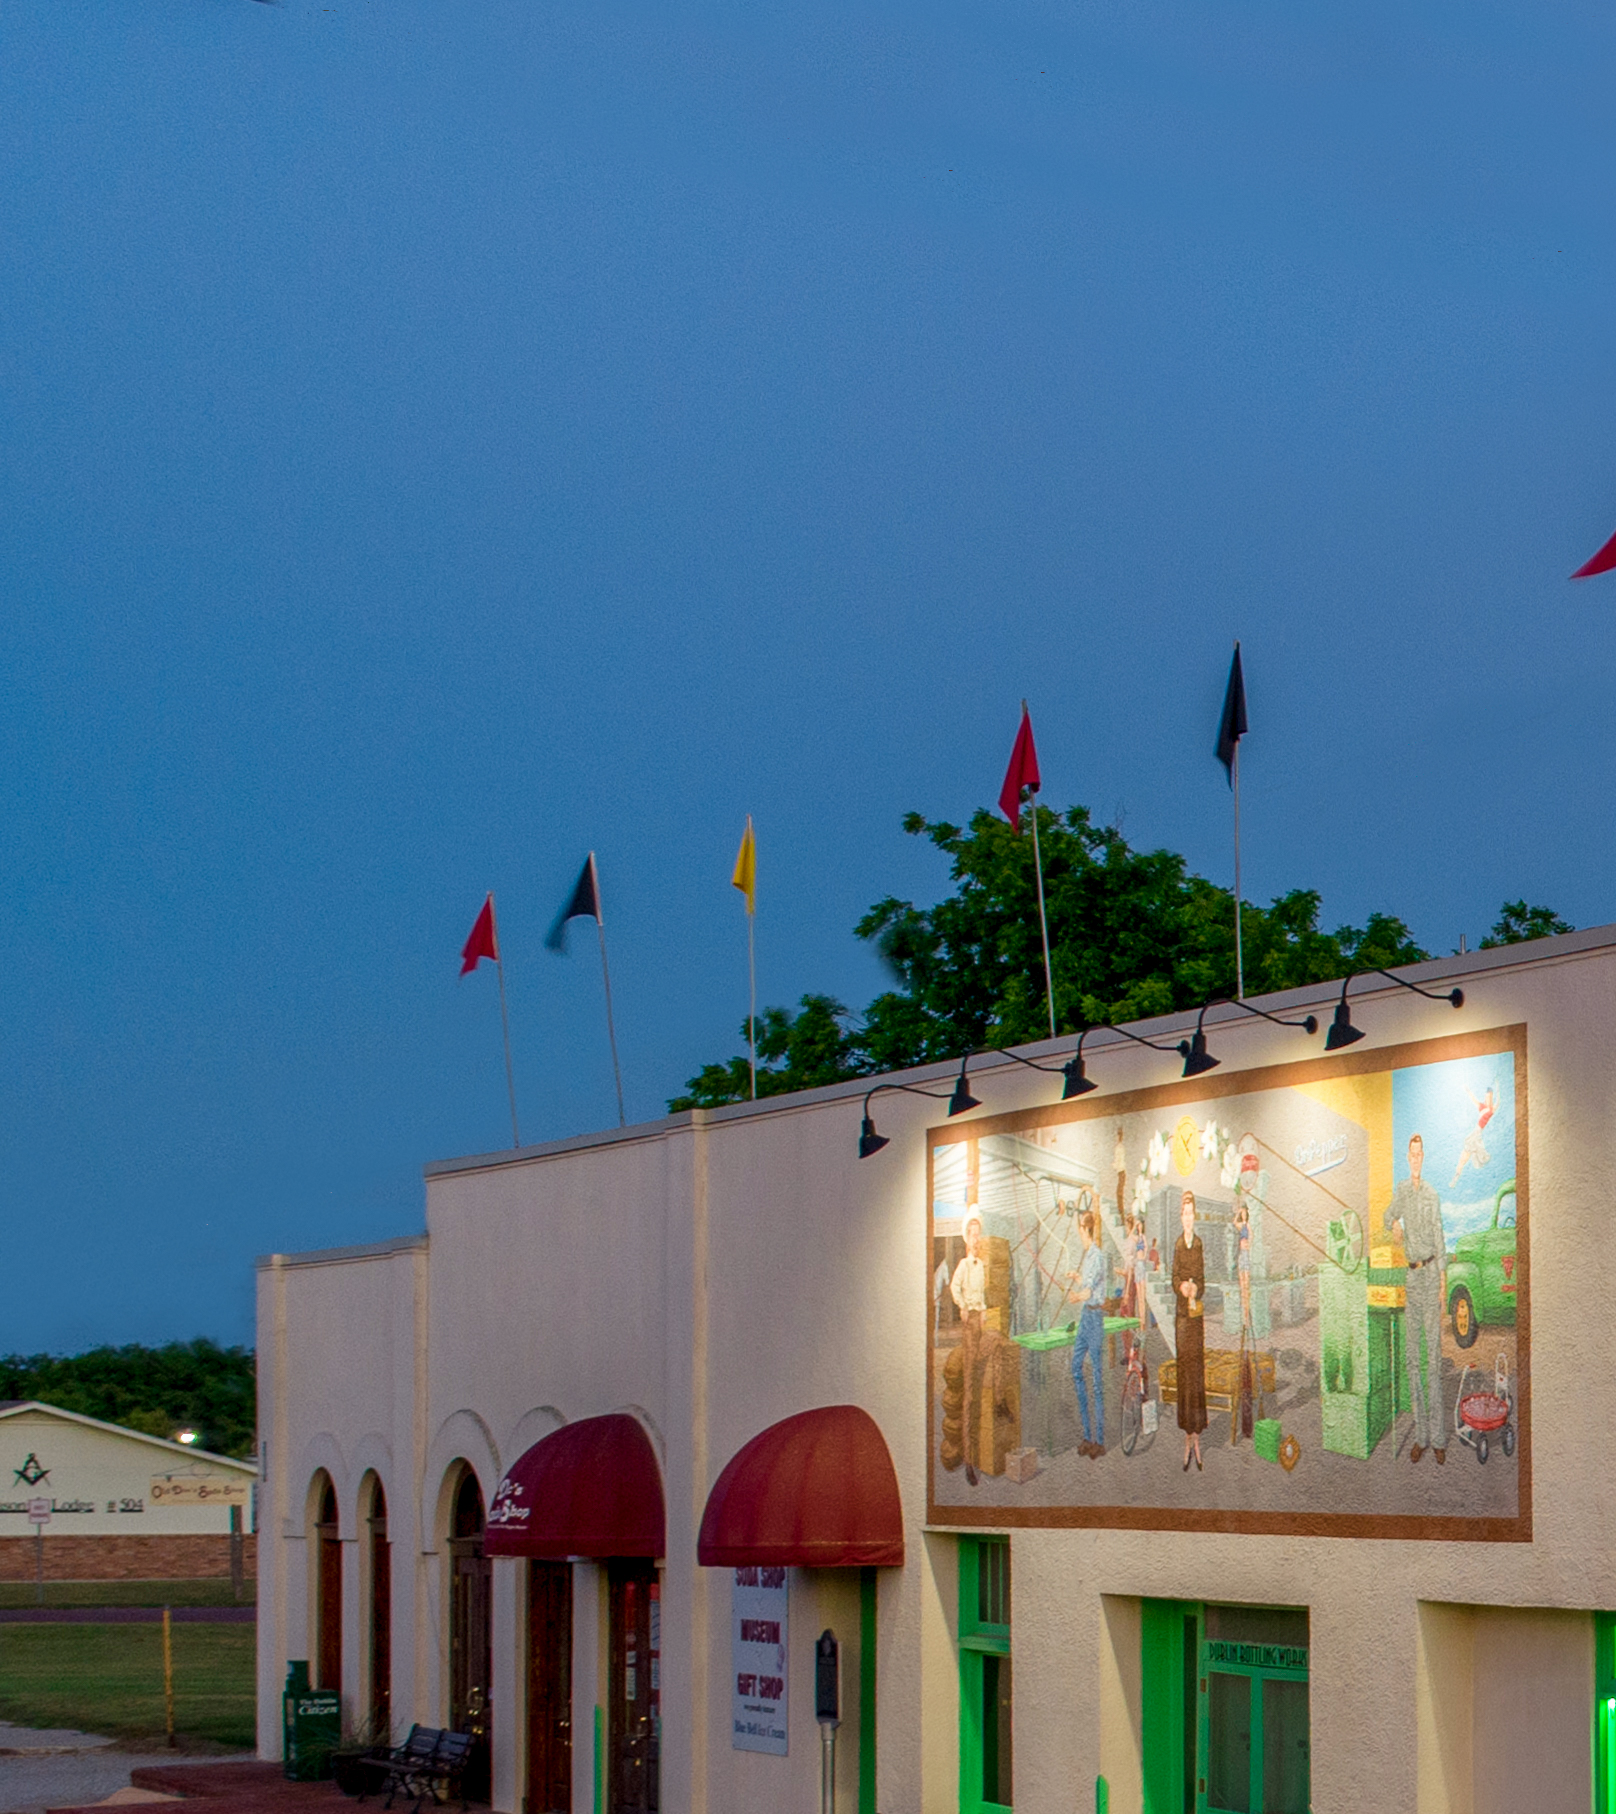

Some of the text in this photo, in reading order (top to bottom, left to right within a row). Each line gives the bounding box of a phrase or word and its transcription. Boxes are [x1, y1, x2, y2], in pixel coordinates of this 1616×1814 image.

[51, 1500, 95, 1513] Lodge
[119, 1499, 145, 1512] 504
[761, 1567, 786, 1589] SHOP
[740, 1618, 781, 1645] MUSEUM
[1209, 1641, 1238, 1661] DUBLIN
[1239, 1644, 1277, 1665] BOTTLING
[737, 1672, 784, 1701] GIFT SHOP
[298, 1706, 339, 1716] Citizen
